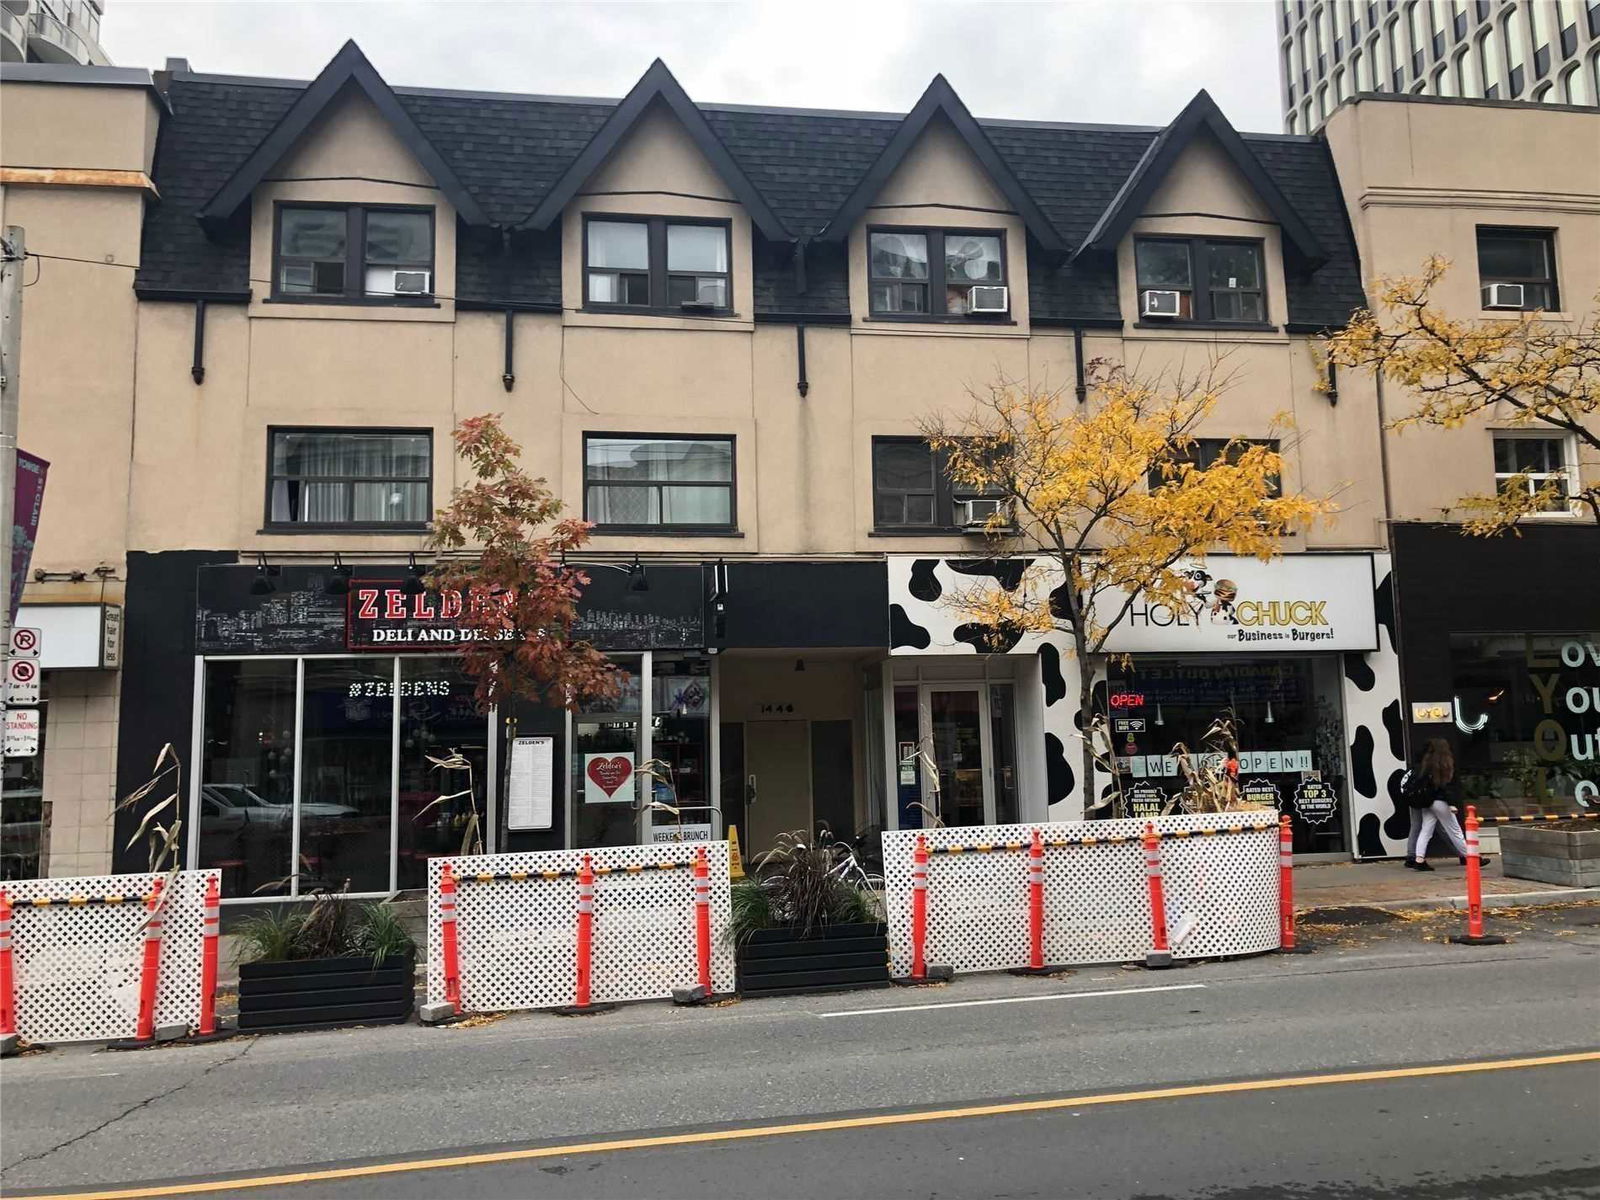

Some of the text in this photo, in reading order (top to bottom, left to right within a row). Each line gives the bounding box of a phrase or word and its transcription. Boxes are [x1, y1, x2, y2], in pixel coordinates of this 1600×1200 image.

[358, 589, 556, 619] ZELDE
[1130, 601, 1329, 626] HOLY CHUCK
[373, 629, 547, 642] DELI AND DESES
[1238, 629, 1284, 643] Business
[1291, 628, 1334, 643] Burgers!
[349, 681, 450, 697] #ZELDENS
[1110, 695, 1145, 706] OPEN
[17, 712, 28, 721] NO
[6, 721, 38, 730] STANDING
[1149, 761, 1173, 774] WE
[1239, 755, 1309, 770] OPEN!!
[1247, 793, 1274, 801] BURGER
[1303, 790, 1319, 798] TOP
[1133, 803, 1161, 812] HALAL
[653, 830, 708, 843] WEEKE BRUNCH
